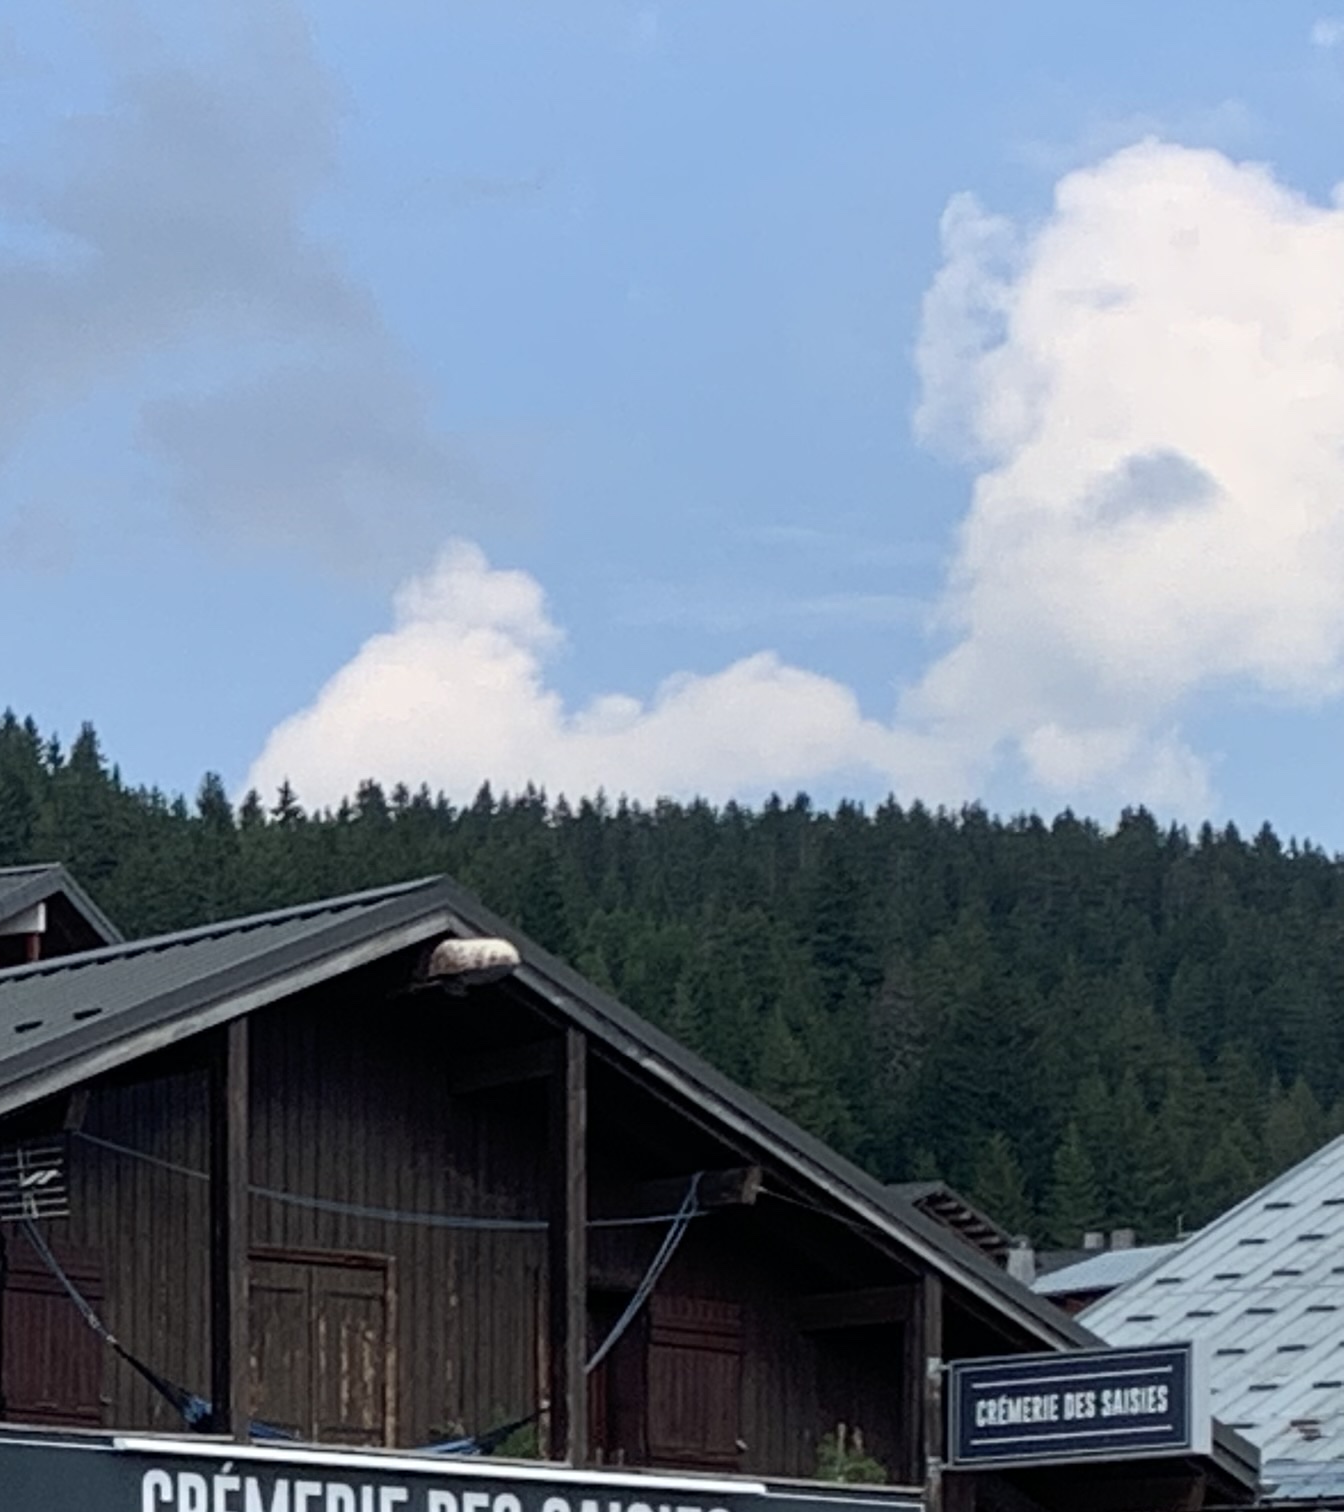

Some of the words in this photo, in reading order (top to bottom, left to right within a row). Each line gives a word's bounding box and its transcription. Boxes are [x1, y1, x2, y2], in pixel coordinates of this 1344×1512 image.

[976, 1394, 1059, 1428] CRÉMERIE
[1063, 1391, 1096, 1420] DES
[1100, 1385, 1169, 1416] SAISIES
